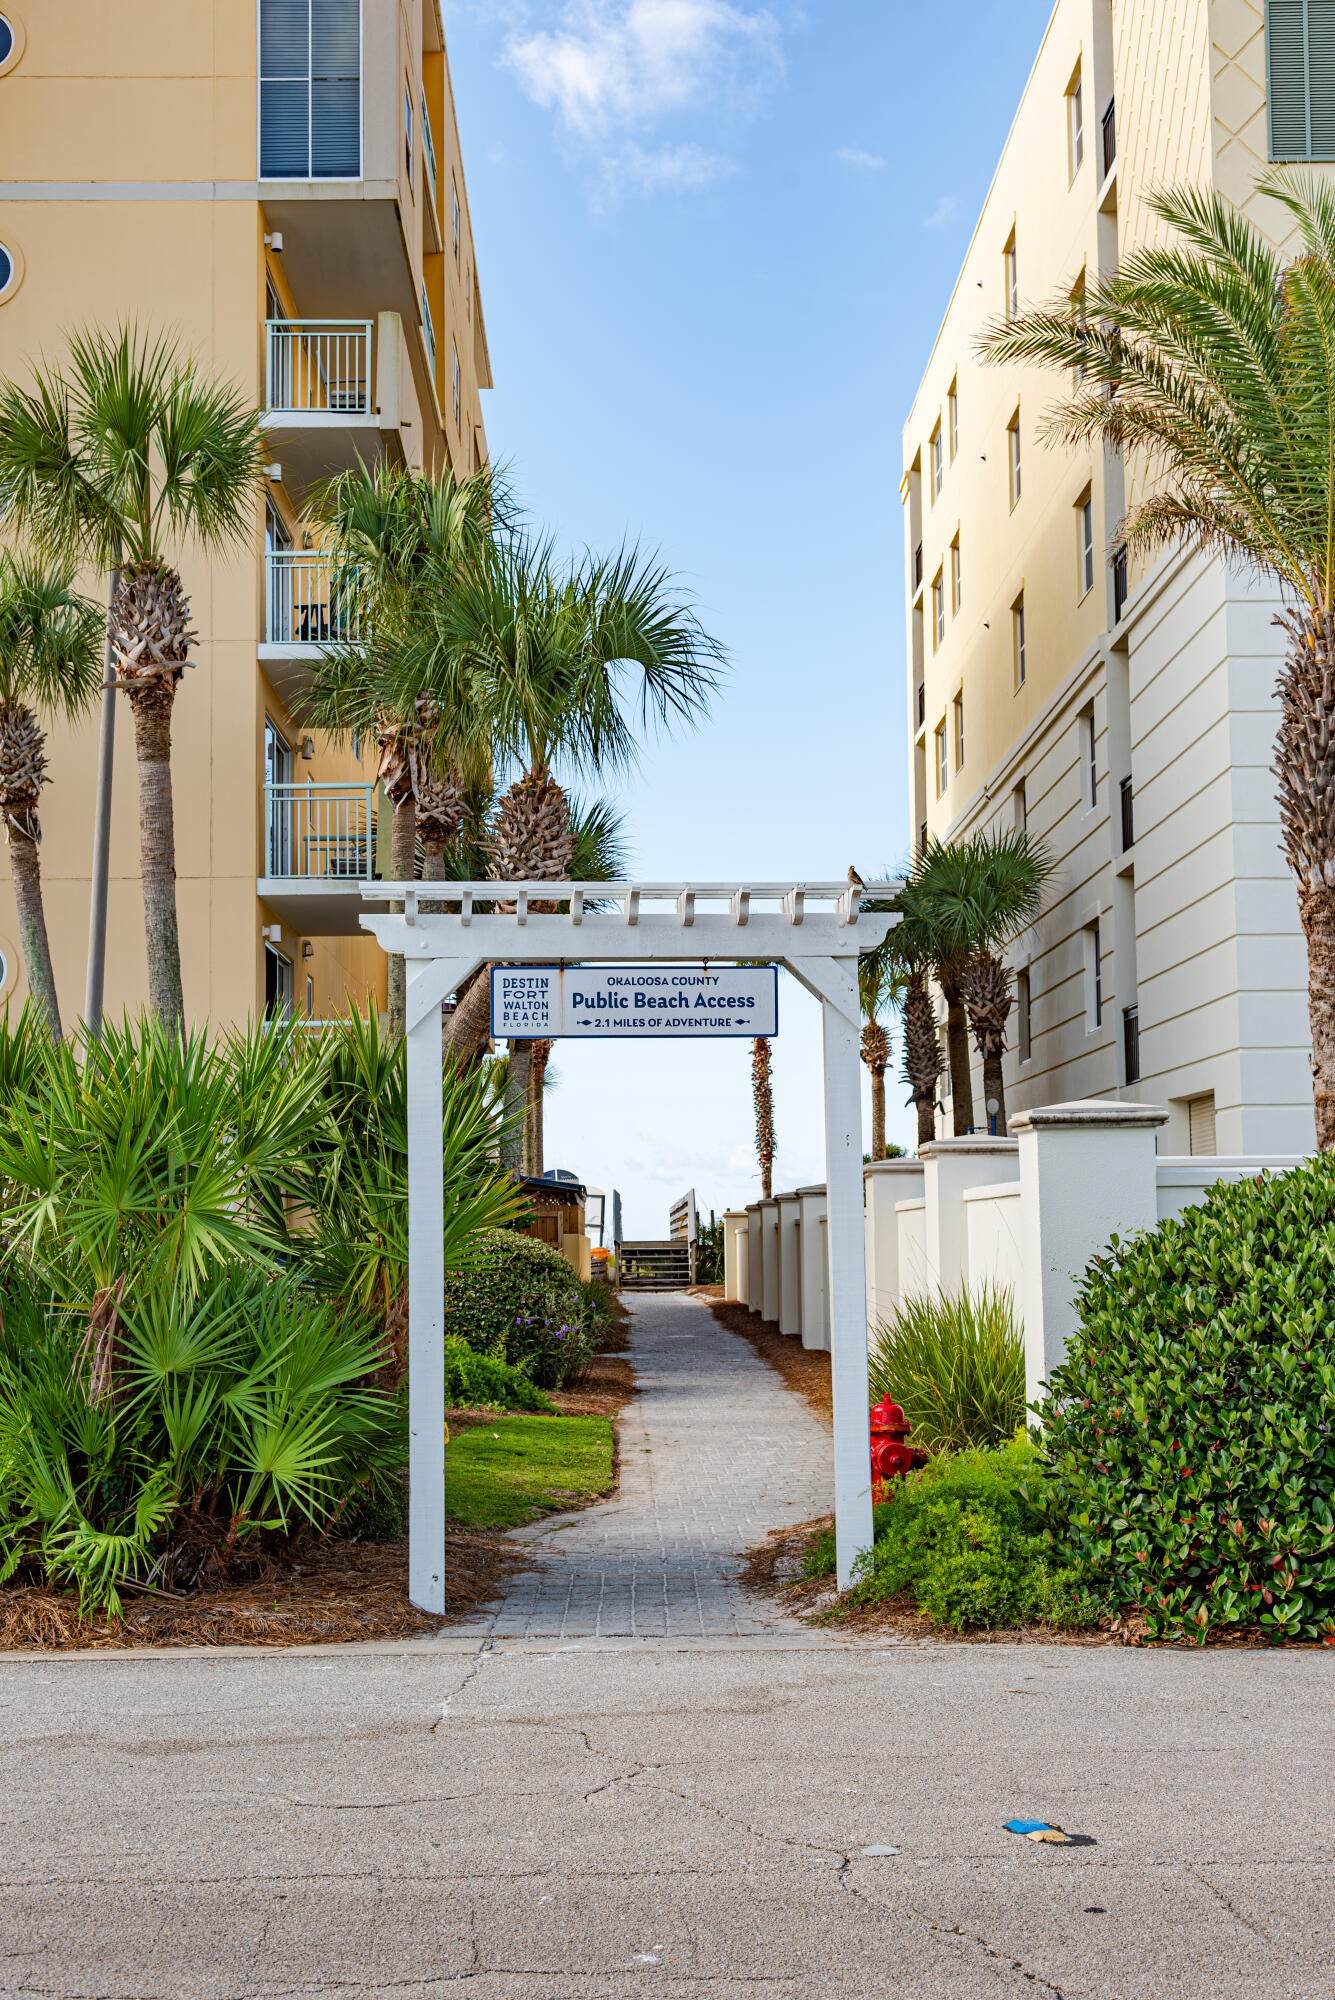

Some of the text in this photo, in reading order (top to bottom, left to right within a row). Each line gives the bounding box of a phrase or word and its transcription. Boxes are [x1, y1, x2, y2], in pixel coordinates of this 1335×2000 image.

[502, 978, 549, 988] DESTIN
[607, 976, 719, 986] OKALOOSA COUNTY
[503, 991, 548, 999] FORT
[572, 992, 755, 1009] Public Beach Access
[503, 1001, 549, 1010] WALTON
[504, 1012, 549, 1021] BEACH
[595, 1018, 731, 1027] 2.1 MILES OF ADVENTURE
